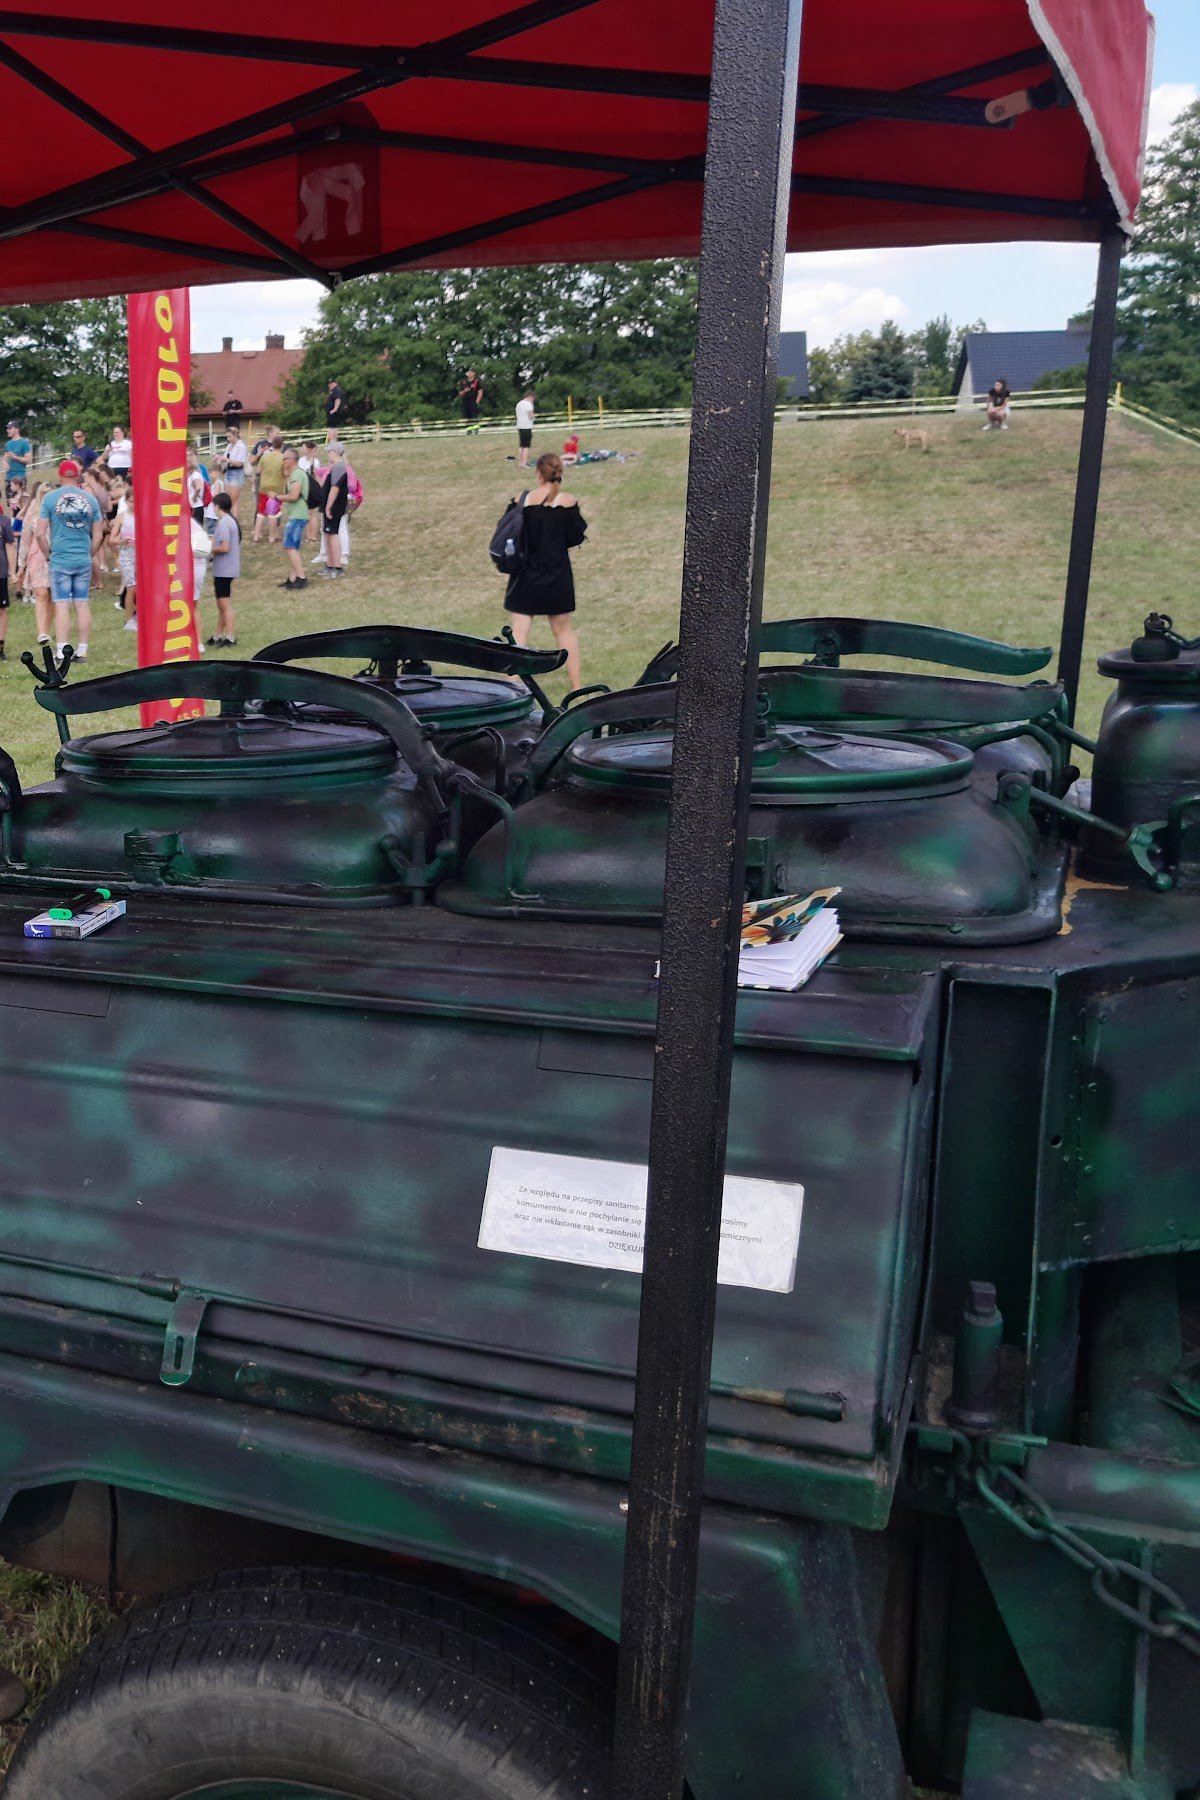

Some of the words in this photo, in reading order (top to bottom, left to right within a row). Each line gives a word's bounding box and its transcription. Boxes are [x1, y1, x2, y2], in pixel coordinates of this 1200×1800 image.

[529, 1188, 560, 1199] względu
[572, 1195, 603, 1206] przepisy
[516, 1199, 568, 1213] konsumentów
[575, 1209, 588, 1217] nie
[588, 1210, 630, 1224] pochylanie
[631, 1217, 642, 1226] się
[514, 1213, 530, 1221] oraz
[544, 1217, 581, 1229] wkładanie
[583, 1224, 596, 1232] rąk
[605, 1228, 641, 1239] zasobniki
